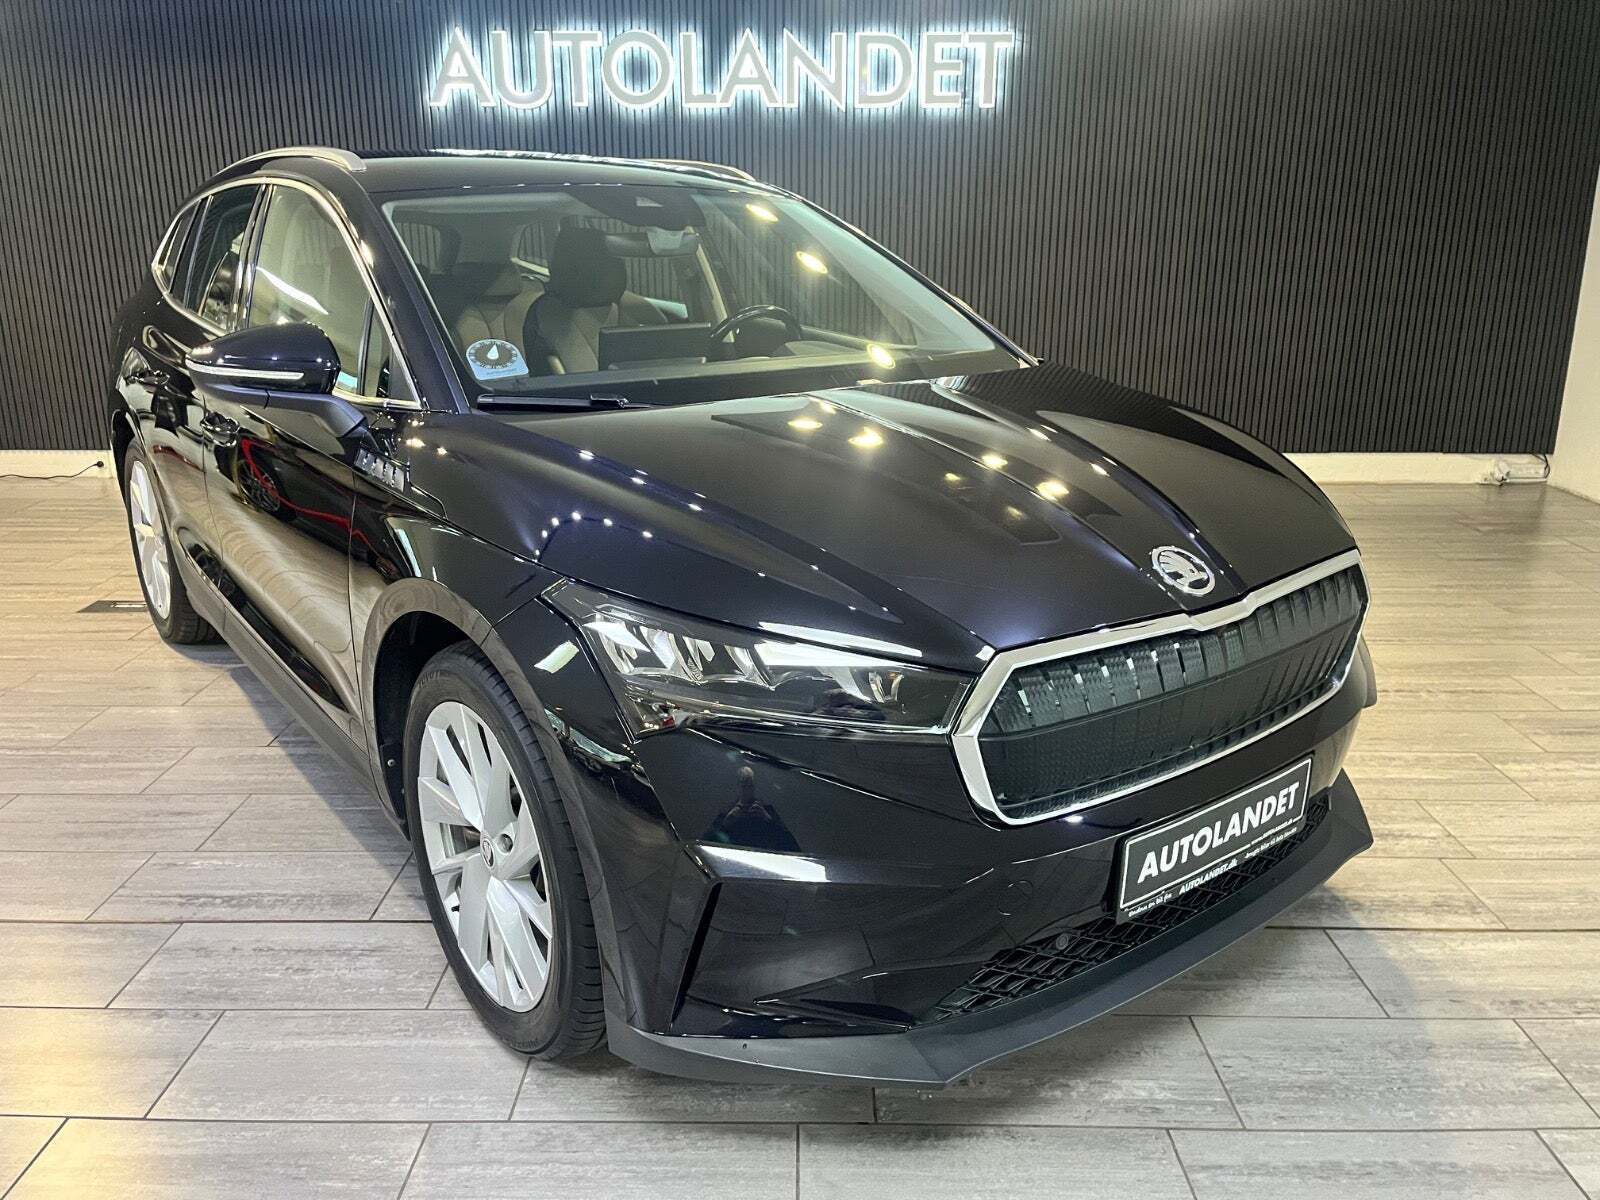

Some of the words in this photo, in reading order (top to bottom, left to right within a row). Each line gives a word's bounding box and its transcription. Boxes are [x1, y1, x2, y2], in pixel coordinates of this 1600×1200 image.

[429, 26, 1014, 112] AUTOLANDET
[1138, 782, 1299, 884] AUTOLANDET
[1179, 858, 1238, 895] AUTOLANDET.dk
